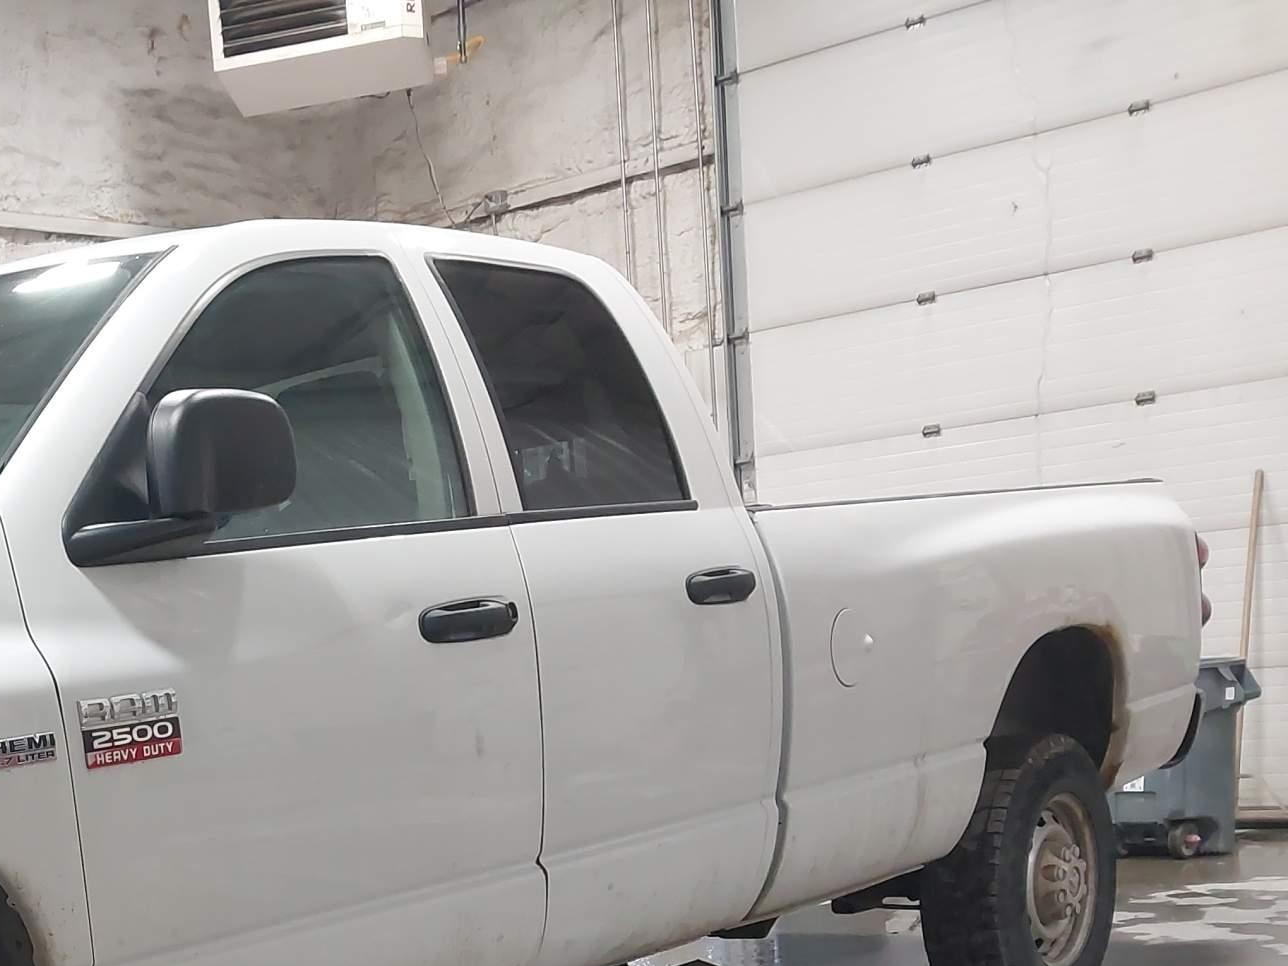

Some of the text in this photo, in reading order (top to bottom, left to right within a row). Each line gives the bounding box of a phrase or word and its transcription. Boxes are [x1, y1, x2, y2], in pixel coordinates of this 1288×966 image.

[92, 721, 173, 750] 2500
[17, 750, 56, 763] LITER
[96, 741, 174, 765] HEAVY DUTY
